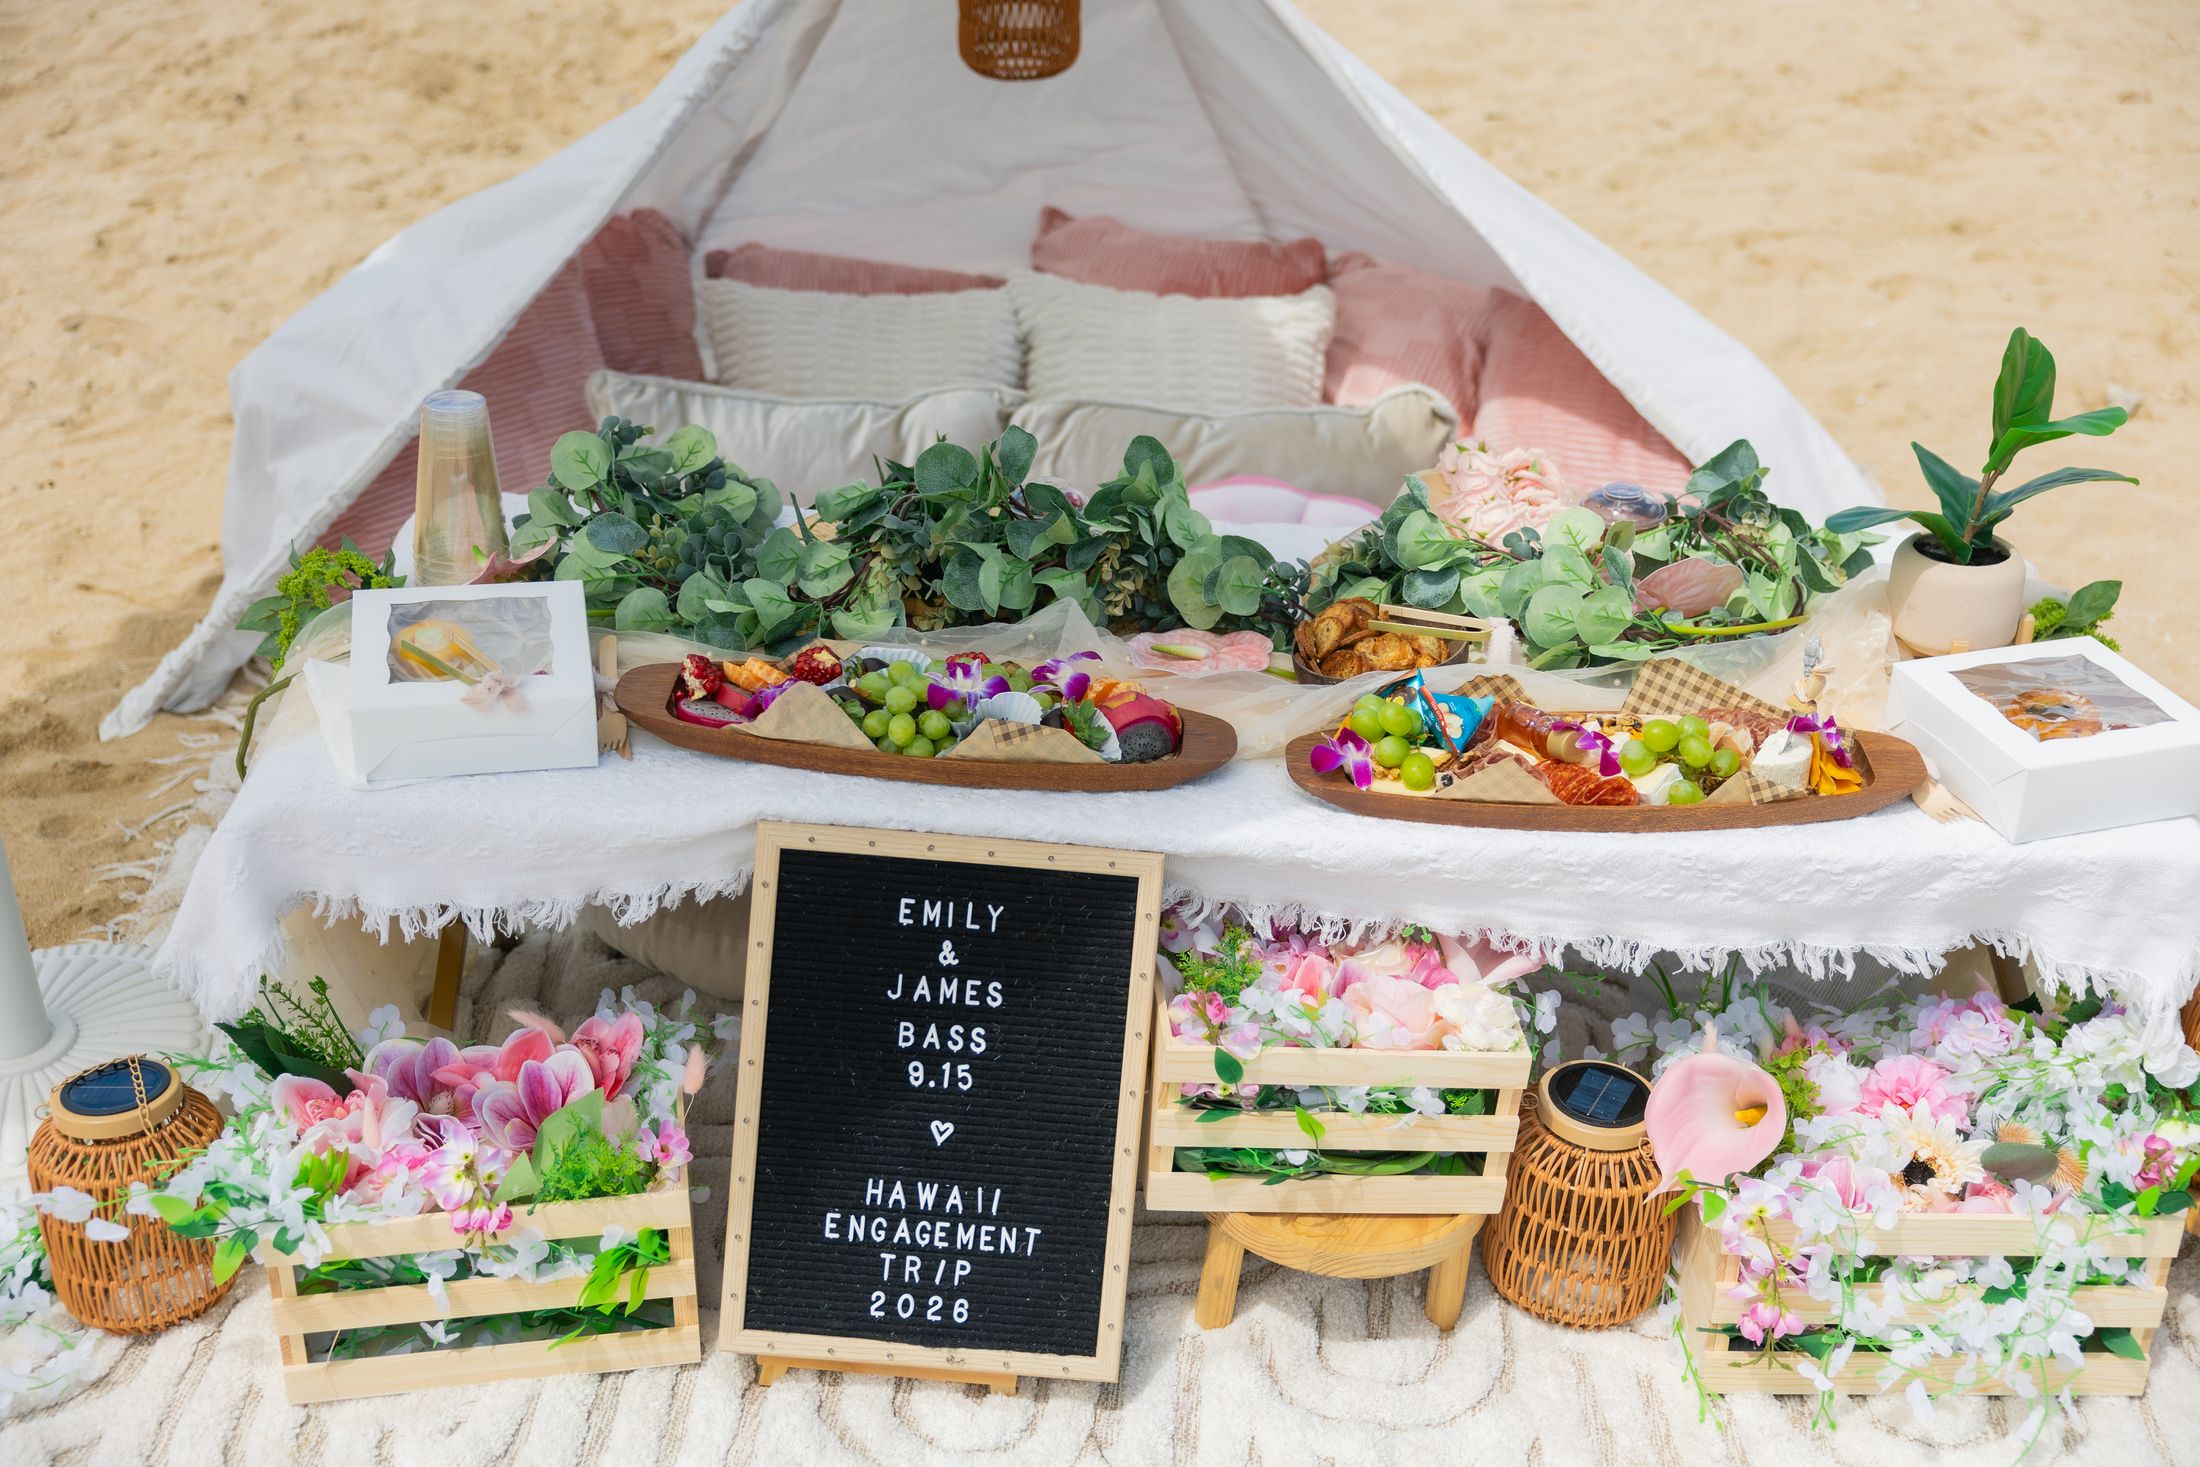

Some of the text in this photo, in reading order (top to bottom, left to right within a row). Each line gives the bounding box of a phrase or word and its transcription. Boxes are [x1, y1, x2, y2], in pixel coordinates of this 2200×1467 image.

[898, 897, 1005, 933] EMILY
[938, 939, 960, 967] &
[887, 973, 1003, 1008] JAMES
[898, 1021, 987, 1055] BASS
[908, 1060, 973, 1091] 9.15
[865, 1177, 1001, 1216] HAWAII
[824, 1212, 1042, 1257] ENGAGEMENT
[879, 1252, 972, 1287] TRIP
[869, 1290, 969, 1324] 2026
